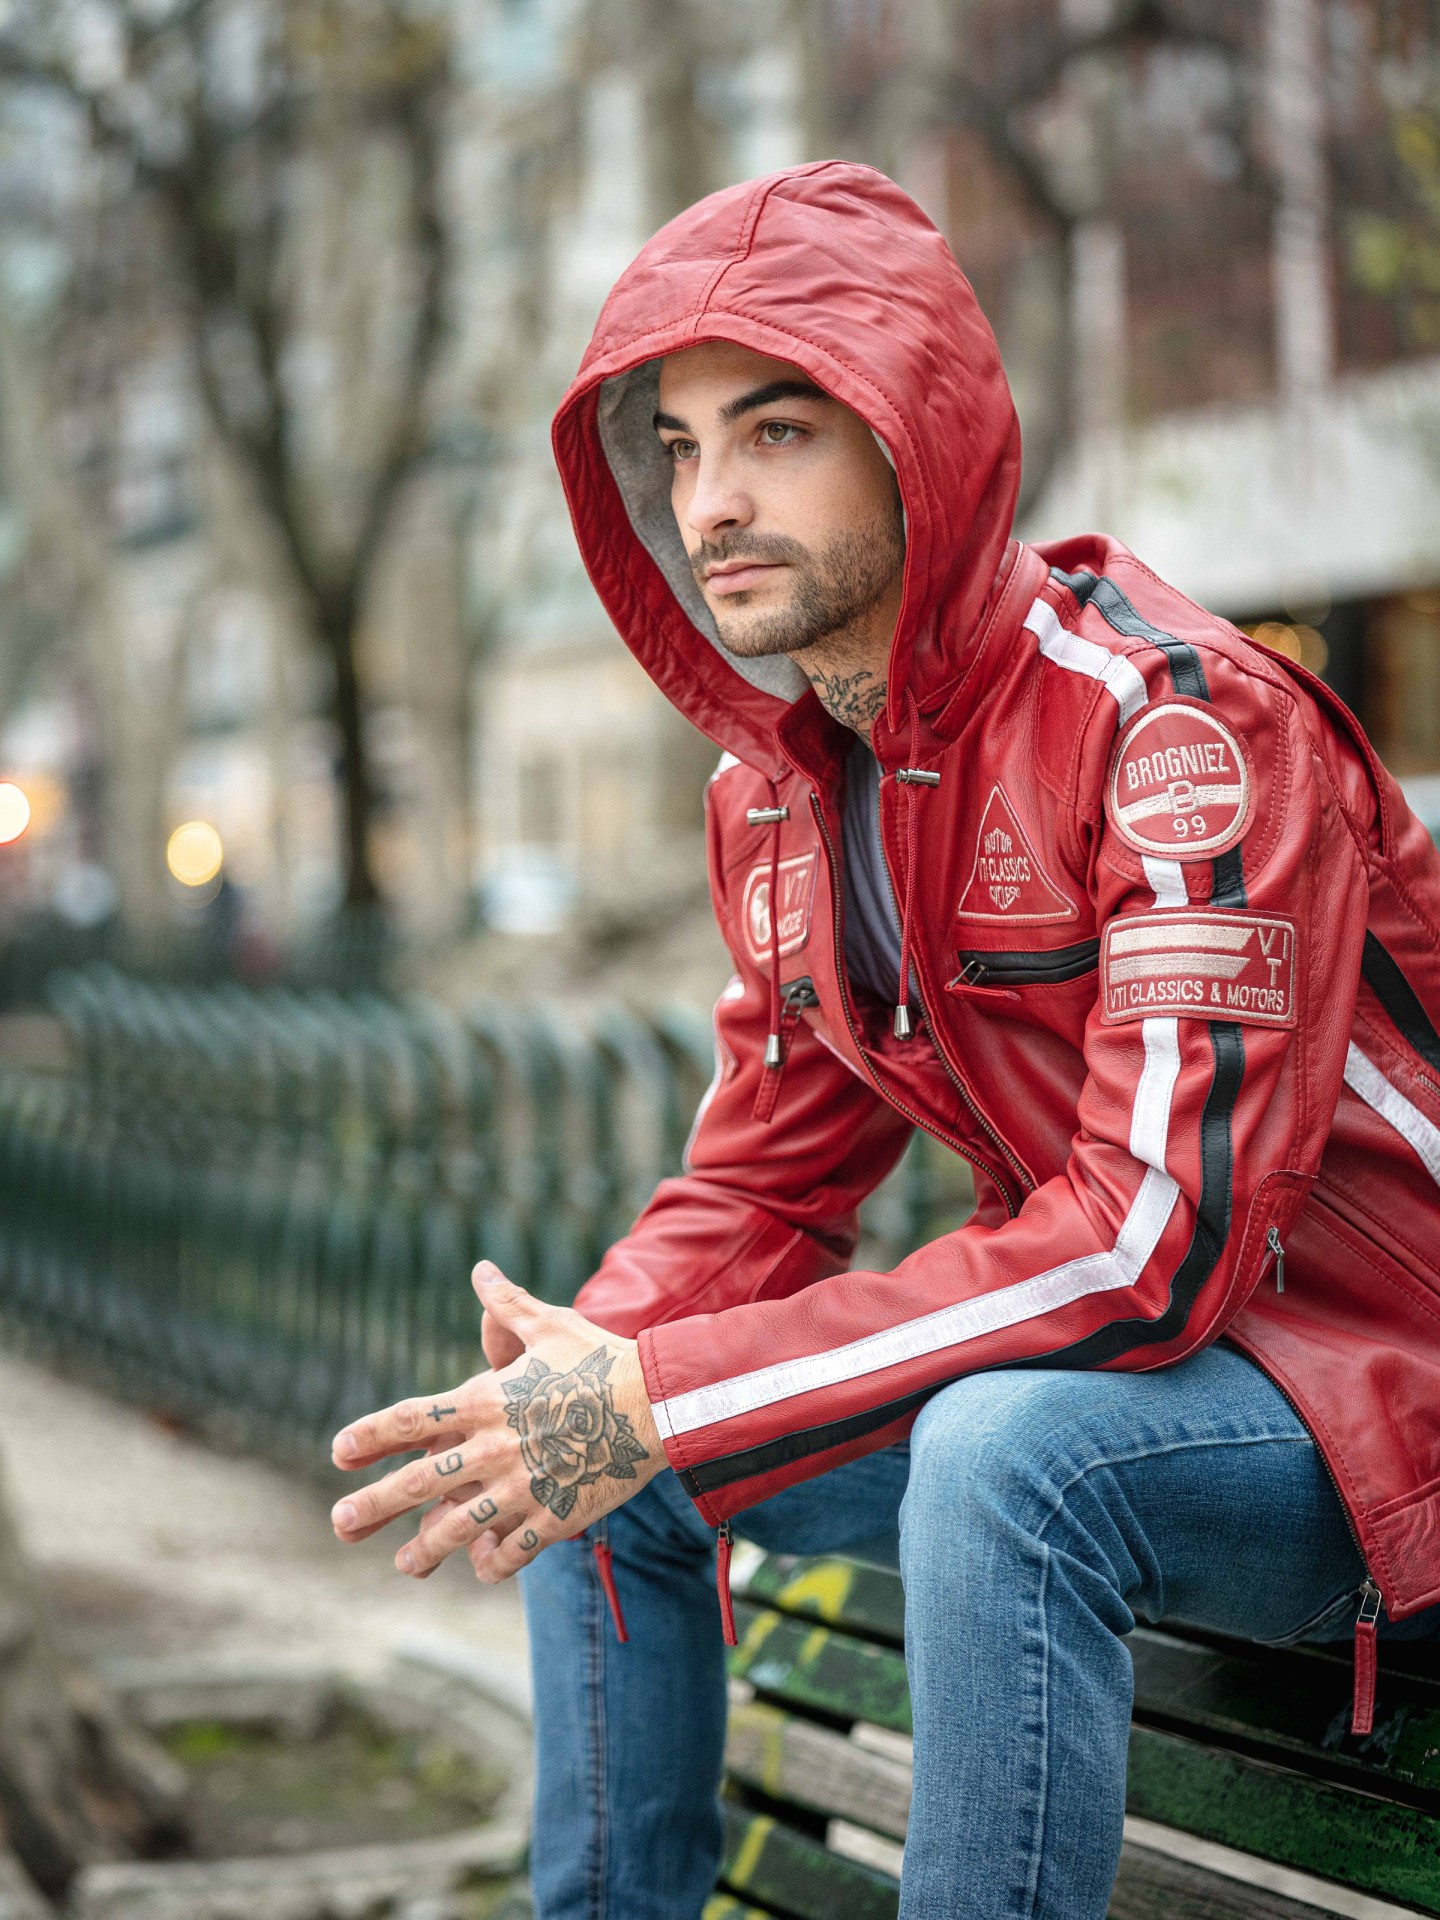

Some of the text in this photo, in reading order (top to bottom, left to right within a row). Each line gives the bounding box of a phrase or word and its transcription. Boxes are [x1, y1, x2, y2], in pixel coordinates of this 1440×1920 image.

[1125, 743, 1231, 791] BROGNIEZ
[1172, 814, 1207, 838] 99
[1109, 979, 1285, 1012] VTI CLASSICS & MOTORS
